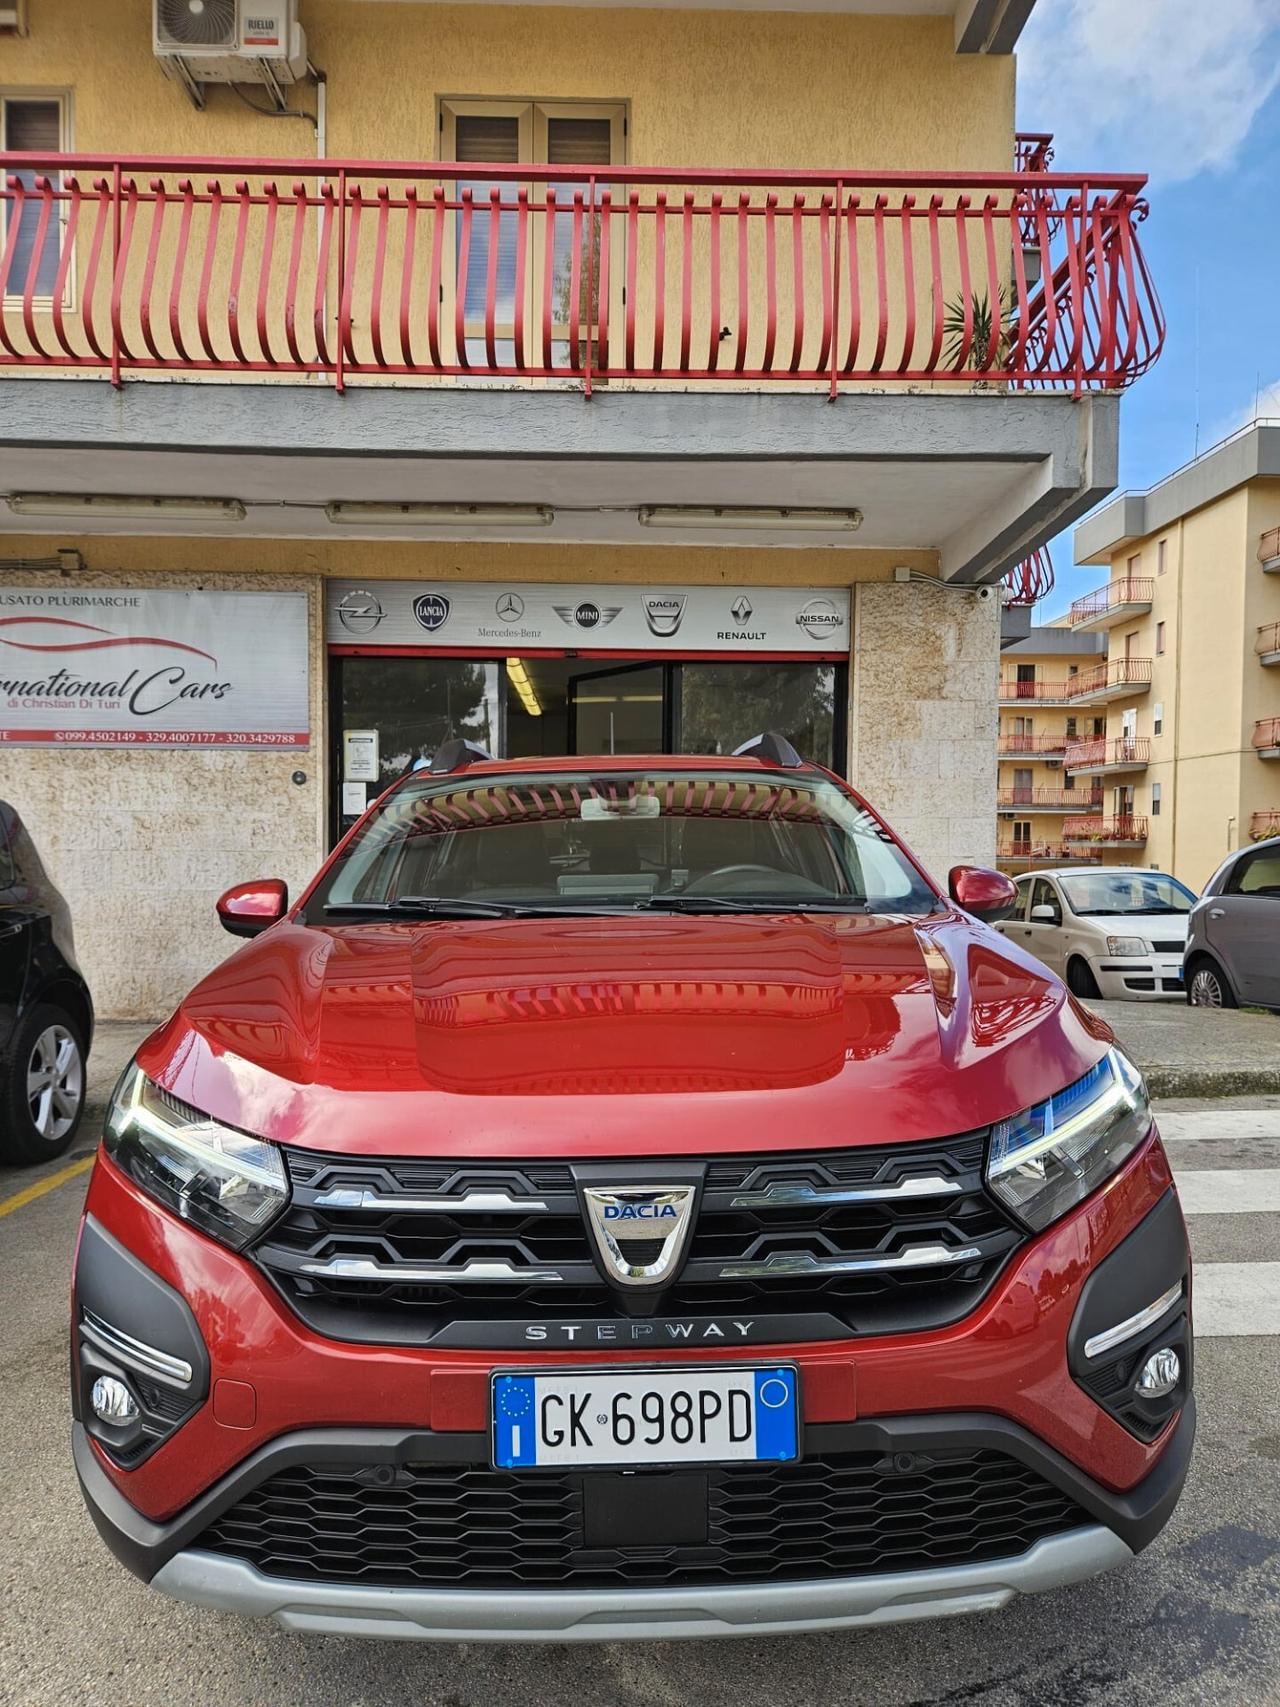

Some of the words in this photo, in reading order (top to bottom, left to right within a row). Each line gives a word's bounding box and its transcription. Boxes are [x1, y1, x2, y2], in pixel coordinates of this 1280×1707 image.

[248, 19, 274, 30] RIELLO
[48, 595, 140, 608] PLURIMARCHE
[648, 600, 680, 609] DACIA
[419, 605, 444, 617] LANCIA
[576, 611, 598, 621] MINI
[800, 614, 840, 624] NISSAN
[477, 627, 542, 638] Mercedes-Benz
[717, 631, 767, 641] RENAULT
[129, 666, 232, 715] Cars
[8, 698, 19, 709] di
[22, 698, 76, 709] Christian
[79, 699, 93, 710] Di
[97, 699, 121, 710] Turi
[65, 731, 136, 742] 099.4502149
[146, 732, 216, 743] 329.4007177
[226, 733, 296, 744] 320.3429788
[603, 1204, 677, 1219] DACIA
[525, 1321, 755, 1341] STEPWAY
